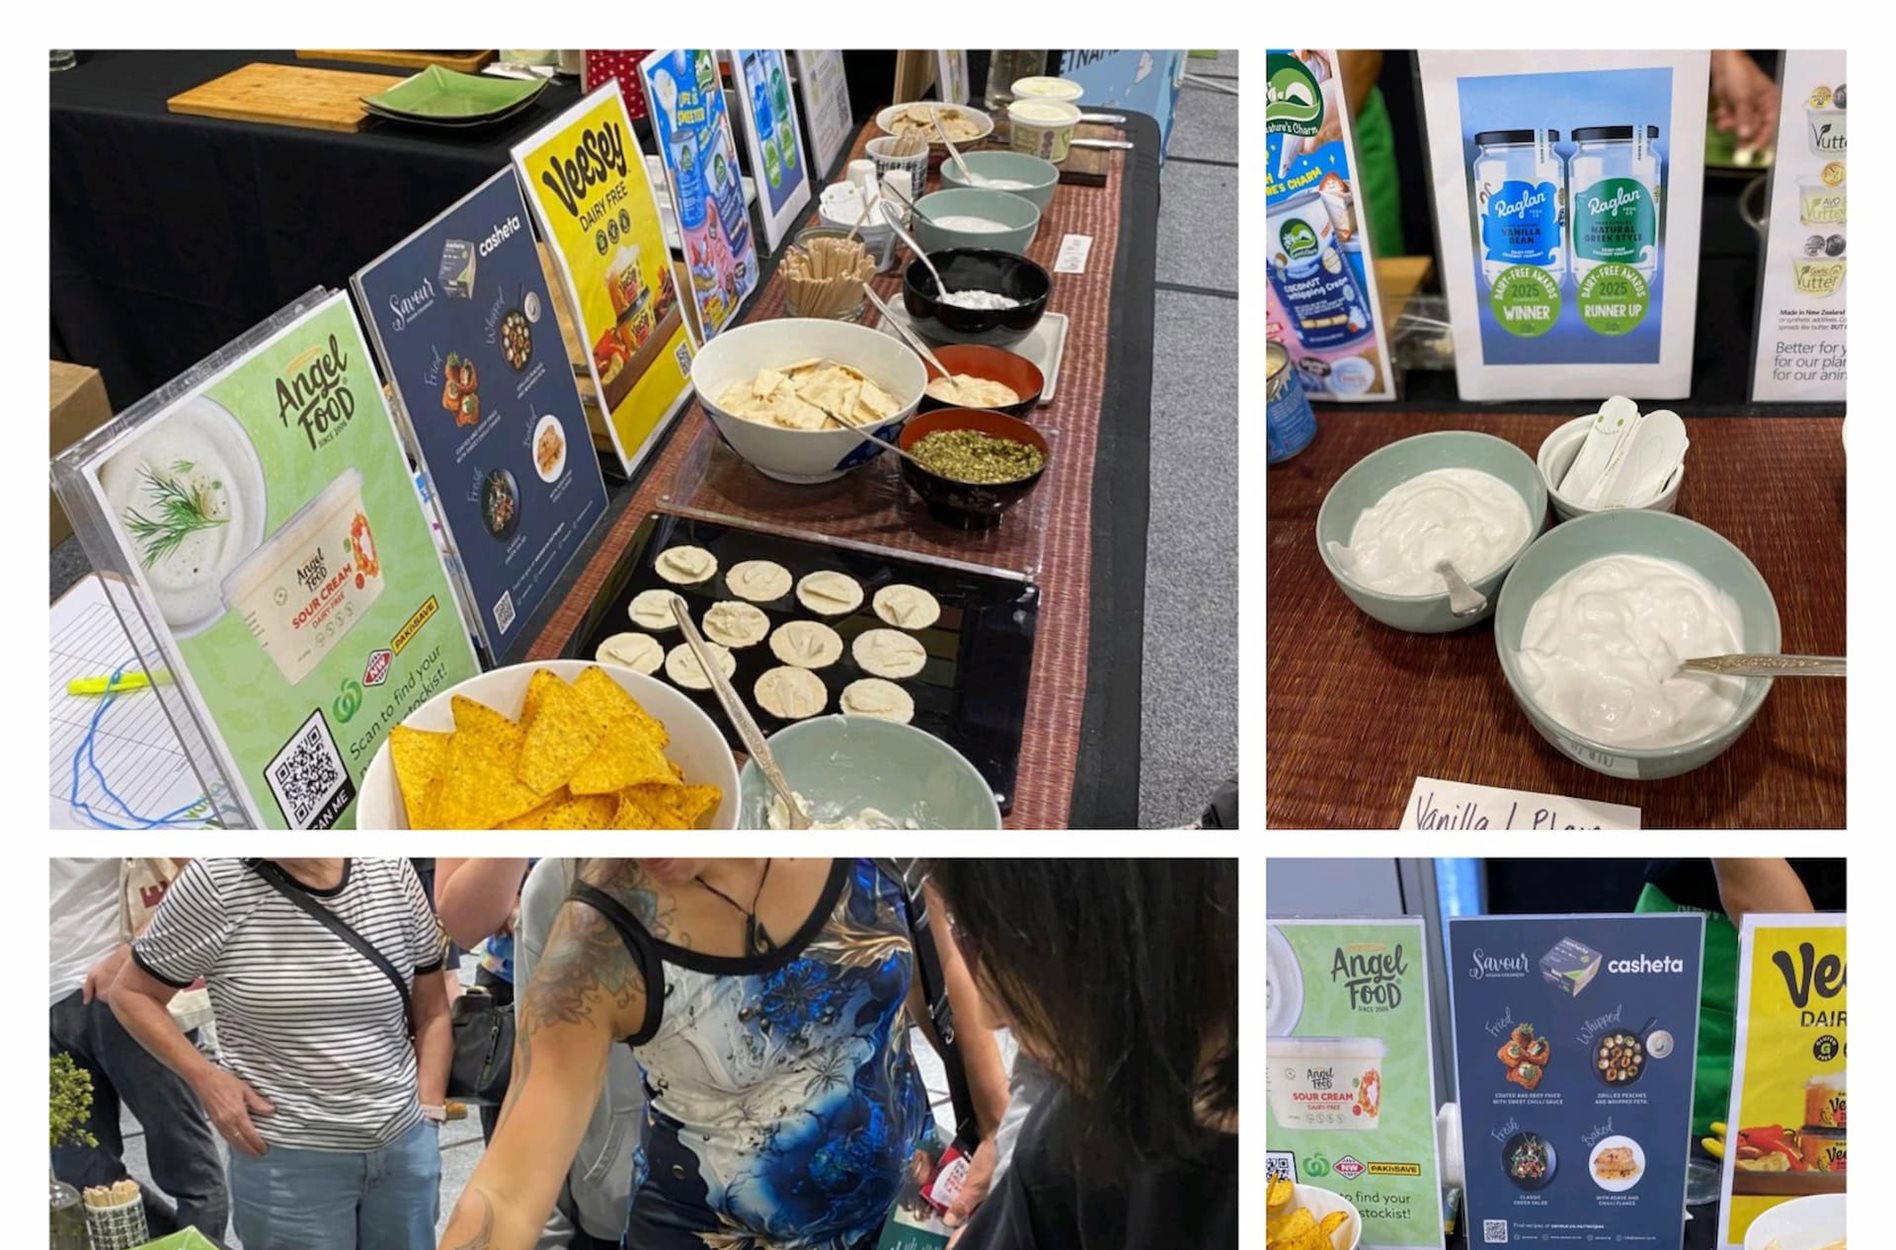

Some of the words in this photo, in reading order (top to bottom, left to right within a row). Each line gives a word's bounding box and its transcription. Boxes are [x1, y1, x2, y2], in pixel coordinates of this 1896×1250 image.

[541, 121, 628, 217] VeeSey
[1287, 167, 1322, 188] CHARM
[579, 201, 606, 233] DAIRY
[605, 180, 629, 208] FREE
[1495, 190, 1545, 219] Raglan
[1588, 187, 1640, 217] Raglan
[479, 216, 521, 257] casheta
[1284, 277, 1321, 294] COCONUT
[1512, 284, 1540, 298] 2025
[1600, 282, 1627, 296] 2025
[390, 278, 435, 331] Savour
[1503, 305, 1550, 321] WINNER
[1584, 304, 1626, 318] RUNNER
[1629, 303, 1643, 317] UP
[1776, 341, 1816, 354] Better
[1819, 341, 1840, 354] for
[1774, 355, 1792, 368] for
[1796, 357, 1818, 368] our
[275, 333, 348, 428] Angel
[1773, 369, 1791, 381] for
[1794, 371, 1817, 381] our
[292, 598, 320, 630] SOUR
[320, 563, 353, 600] CREAM
[369, 657, 387, 680] NW
[349, 722, 381, 761] Scan
[380, 703, 395, 723] to
[393, 671, 416, 705] find
[415, 645, 441, 681] your
[333, 789, 349, 810] ME
[1331, 943, 1408, 984] Angel
[1469, 948, 1530, 980] Savour
[1607, 954, 1684, 974] casheta
[1484, 1006, 1515, 1038] Fried
[1576, 1003, 1623, 1046] Whipped
[1293, 1092, 1320, 1101] SOUR
[1321, 1092, 1354, 1101] CREAM
[1341, 1162, 1359, 1172] NW
[1356, 1191, 1380, 1203] find
[1383, 1194, 1411, 1205] your
[1359, 1207, 1412, 1220] stockist!
